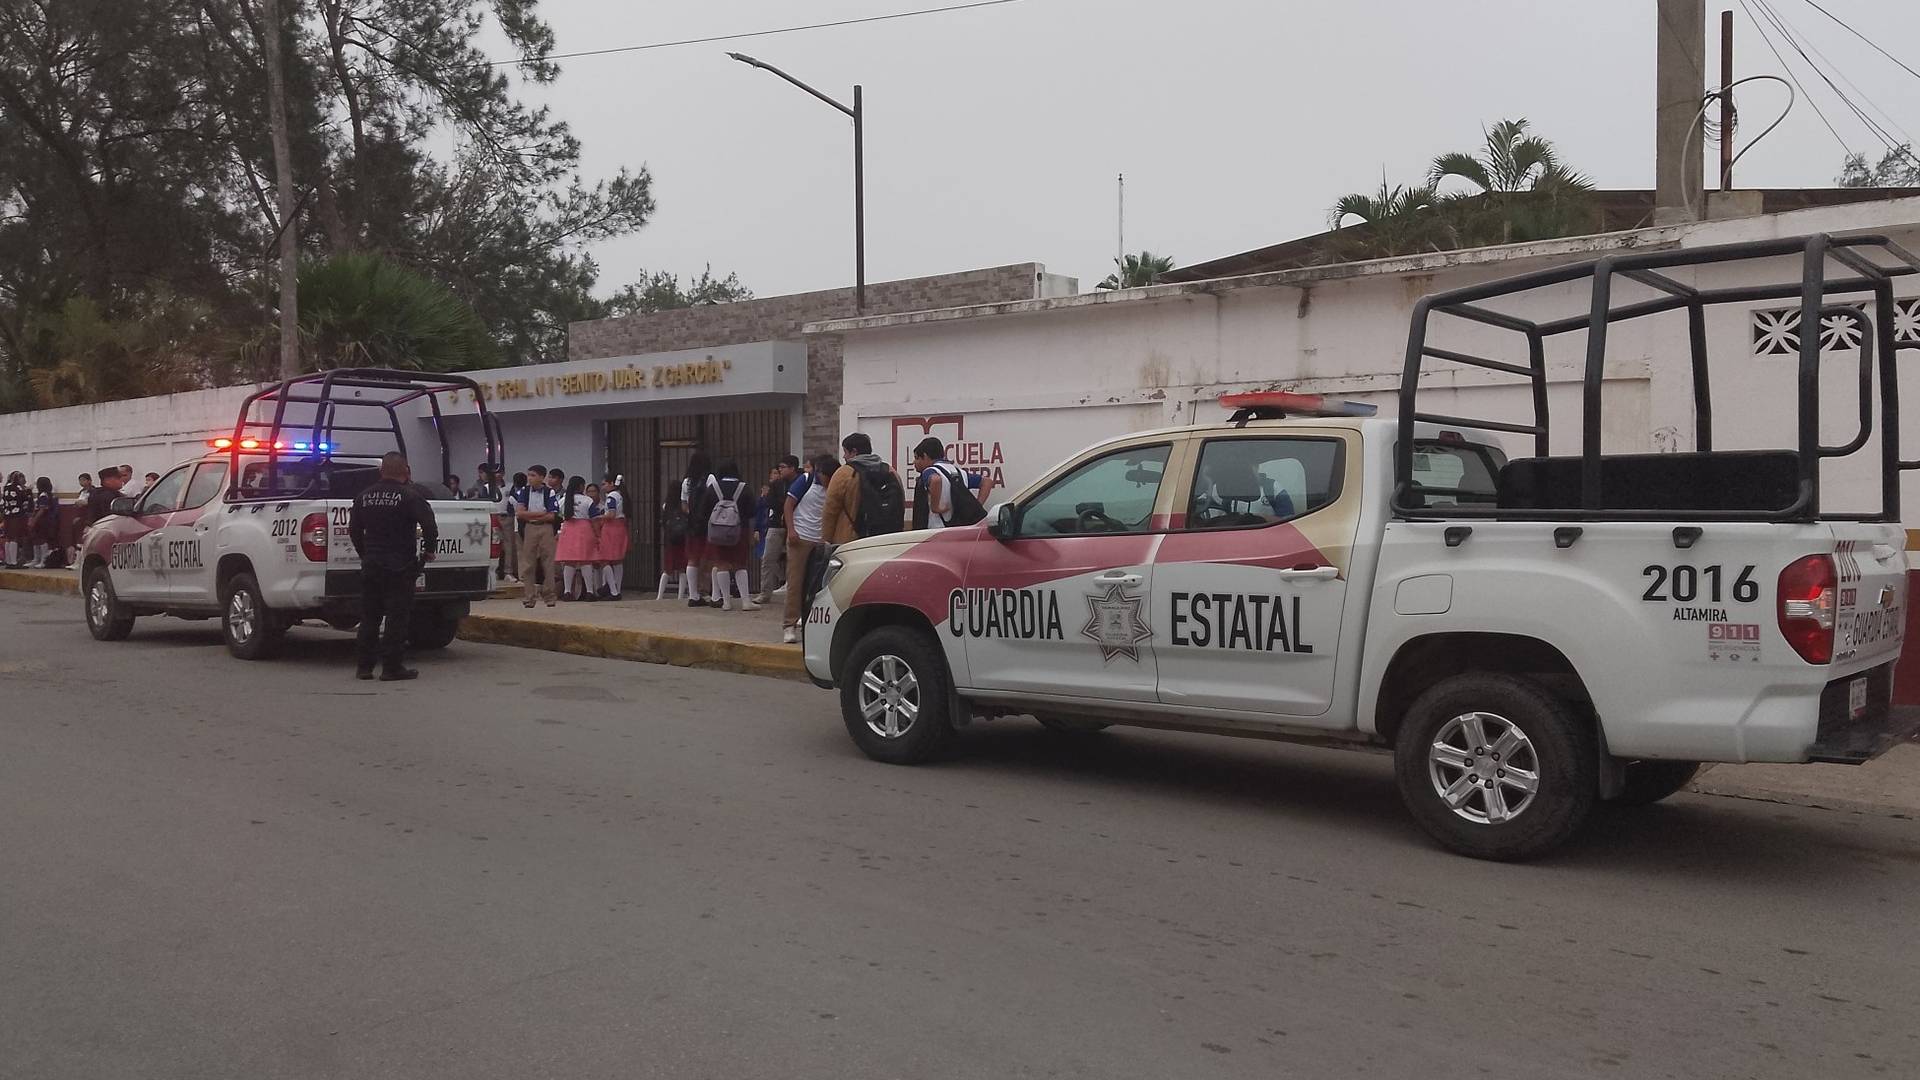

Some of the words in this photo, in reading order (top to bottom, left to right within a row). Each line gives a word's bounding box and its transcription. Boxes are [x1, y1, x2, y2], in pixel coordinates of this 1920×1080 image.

[944, 441, 1004, 465] CUELA
[331, 506, 352, 526] 201
[272, 519, 298, 537] 2012
[111, 542, 145, 570] GUARDIA
[168, 540, 204, 569] ESTATAL
[420, 538, 465, 554] ETATAL
[1642, 564, 1759, 603] 2016
[808, 605, 832, 624] 2016
[948, 587, 1065, 641] GUARDIA
[1171, 591, 1314, 654] ESTATAL
[1673, 607, 1728, 622] ALTAMIRA
[1710, 624, 1757, 639] 911
